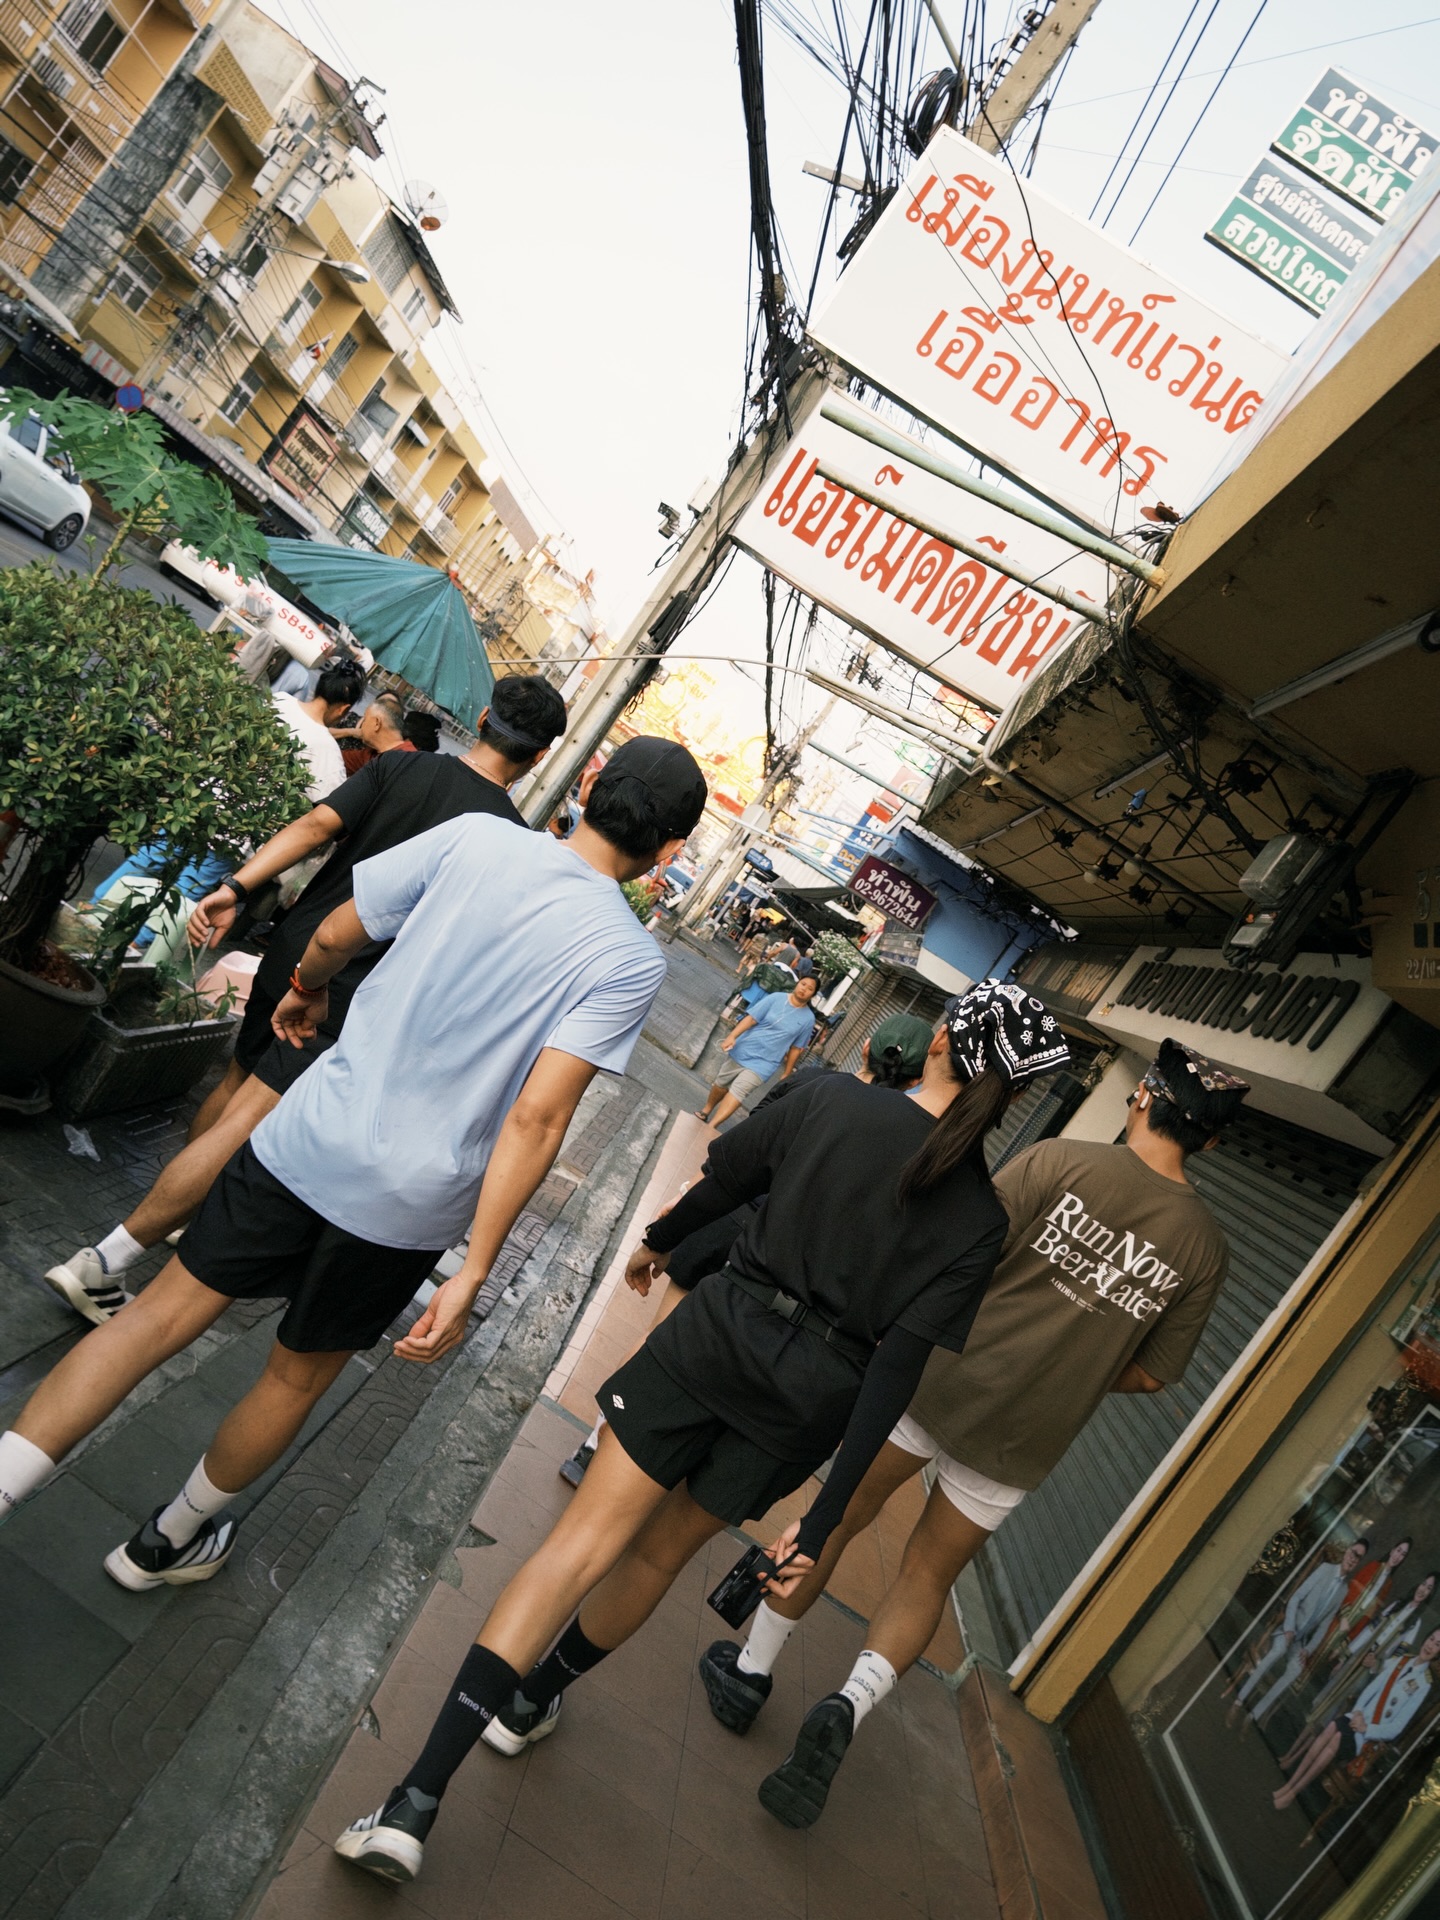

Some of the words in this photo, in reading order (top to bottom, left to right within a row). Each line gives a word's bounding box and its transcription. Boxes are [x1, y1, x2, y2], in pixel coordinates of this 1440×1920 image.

[915, 293, 1169, 497] เอื้ออาทร
[277, 607, 317, 641] SB45
[854, 878, 920, 928] 02-9672644
[867, 868, 922, 912] ทำฟัน
[1029, 1223, 1095, 1279] Beer
[1045, 1191, 1115, 1256] Run
[1104, 1230, 1185, 1293] Now
[457, 1691, 480, 1711] Time
